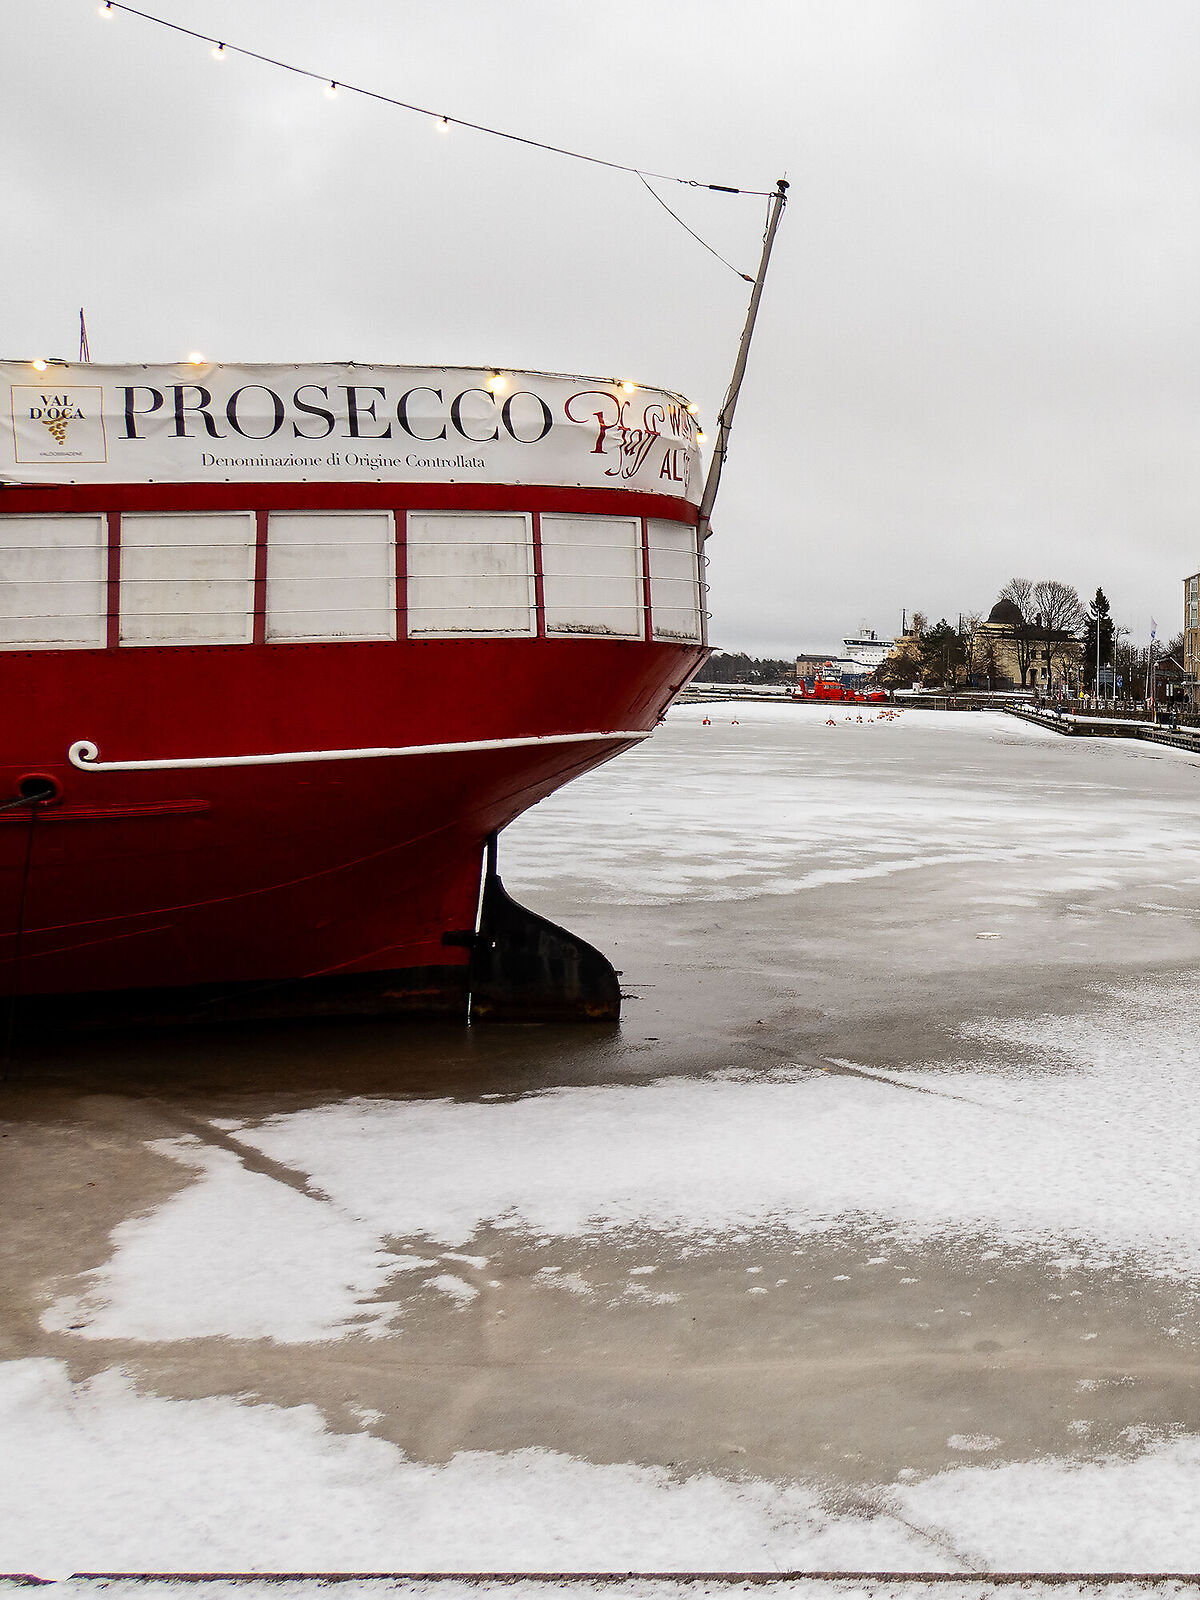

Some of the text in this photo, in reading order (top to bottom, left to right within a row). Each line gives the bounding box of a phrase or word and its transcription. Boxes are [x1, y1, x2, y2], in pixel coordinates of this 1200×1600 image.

[40, 395, 74, 406] VAL
[29, 407, 86, 420] D'OCA
[115, 384, 553, 442] PROSECCO
[201, 452, 485, 471] Denominazione di Origine Controllata
